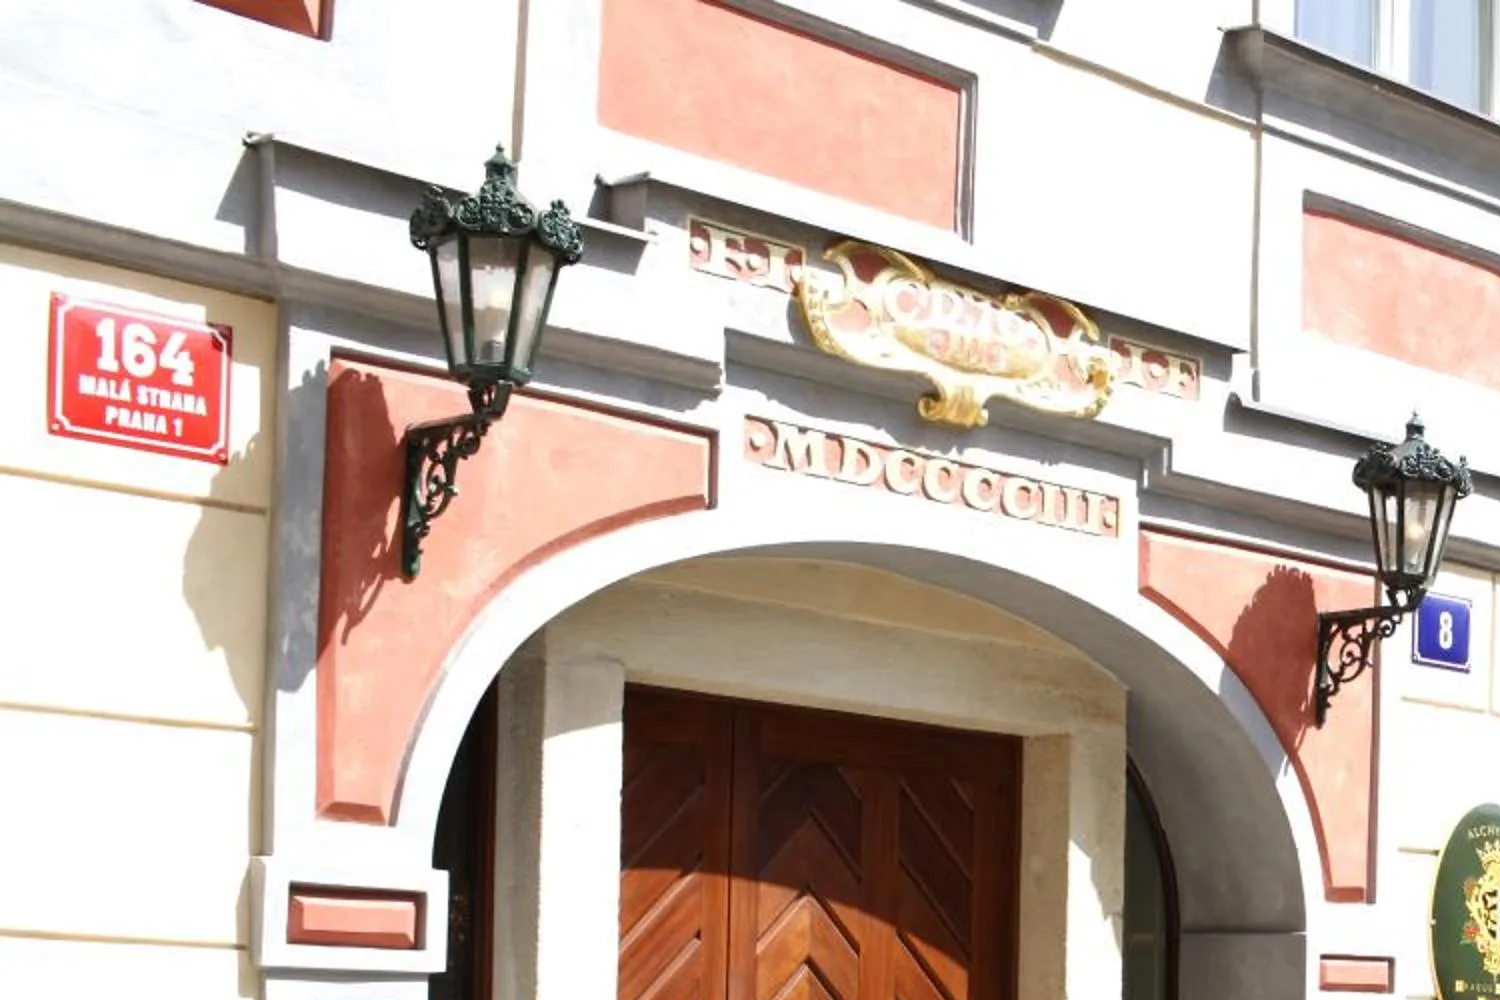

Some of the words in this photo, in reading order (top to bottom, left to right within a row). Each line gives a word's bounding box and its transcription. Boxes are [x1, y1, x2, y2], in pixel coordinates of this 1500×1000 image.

[95, 317, 195, 387] 164
[136, 384, 208, 416] STRANA
[105, 405, 168, 434] PRAHA
[172, 418, 183, 437] 1
[1439, 610, 1453, 650] 8
